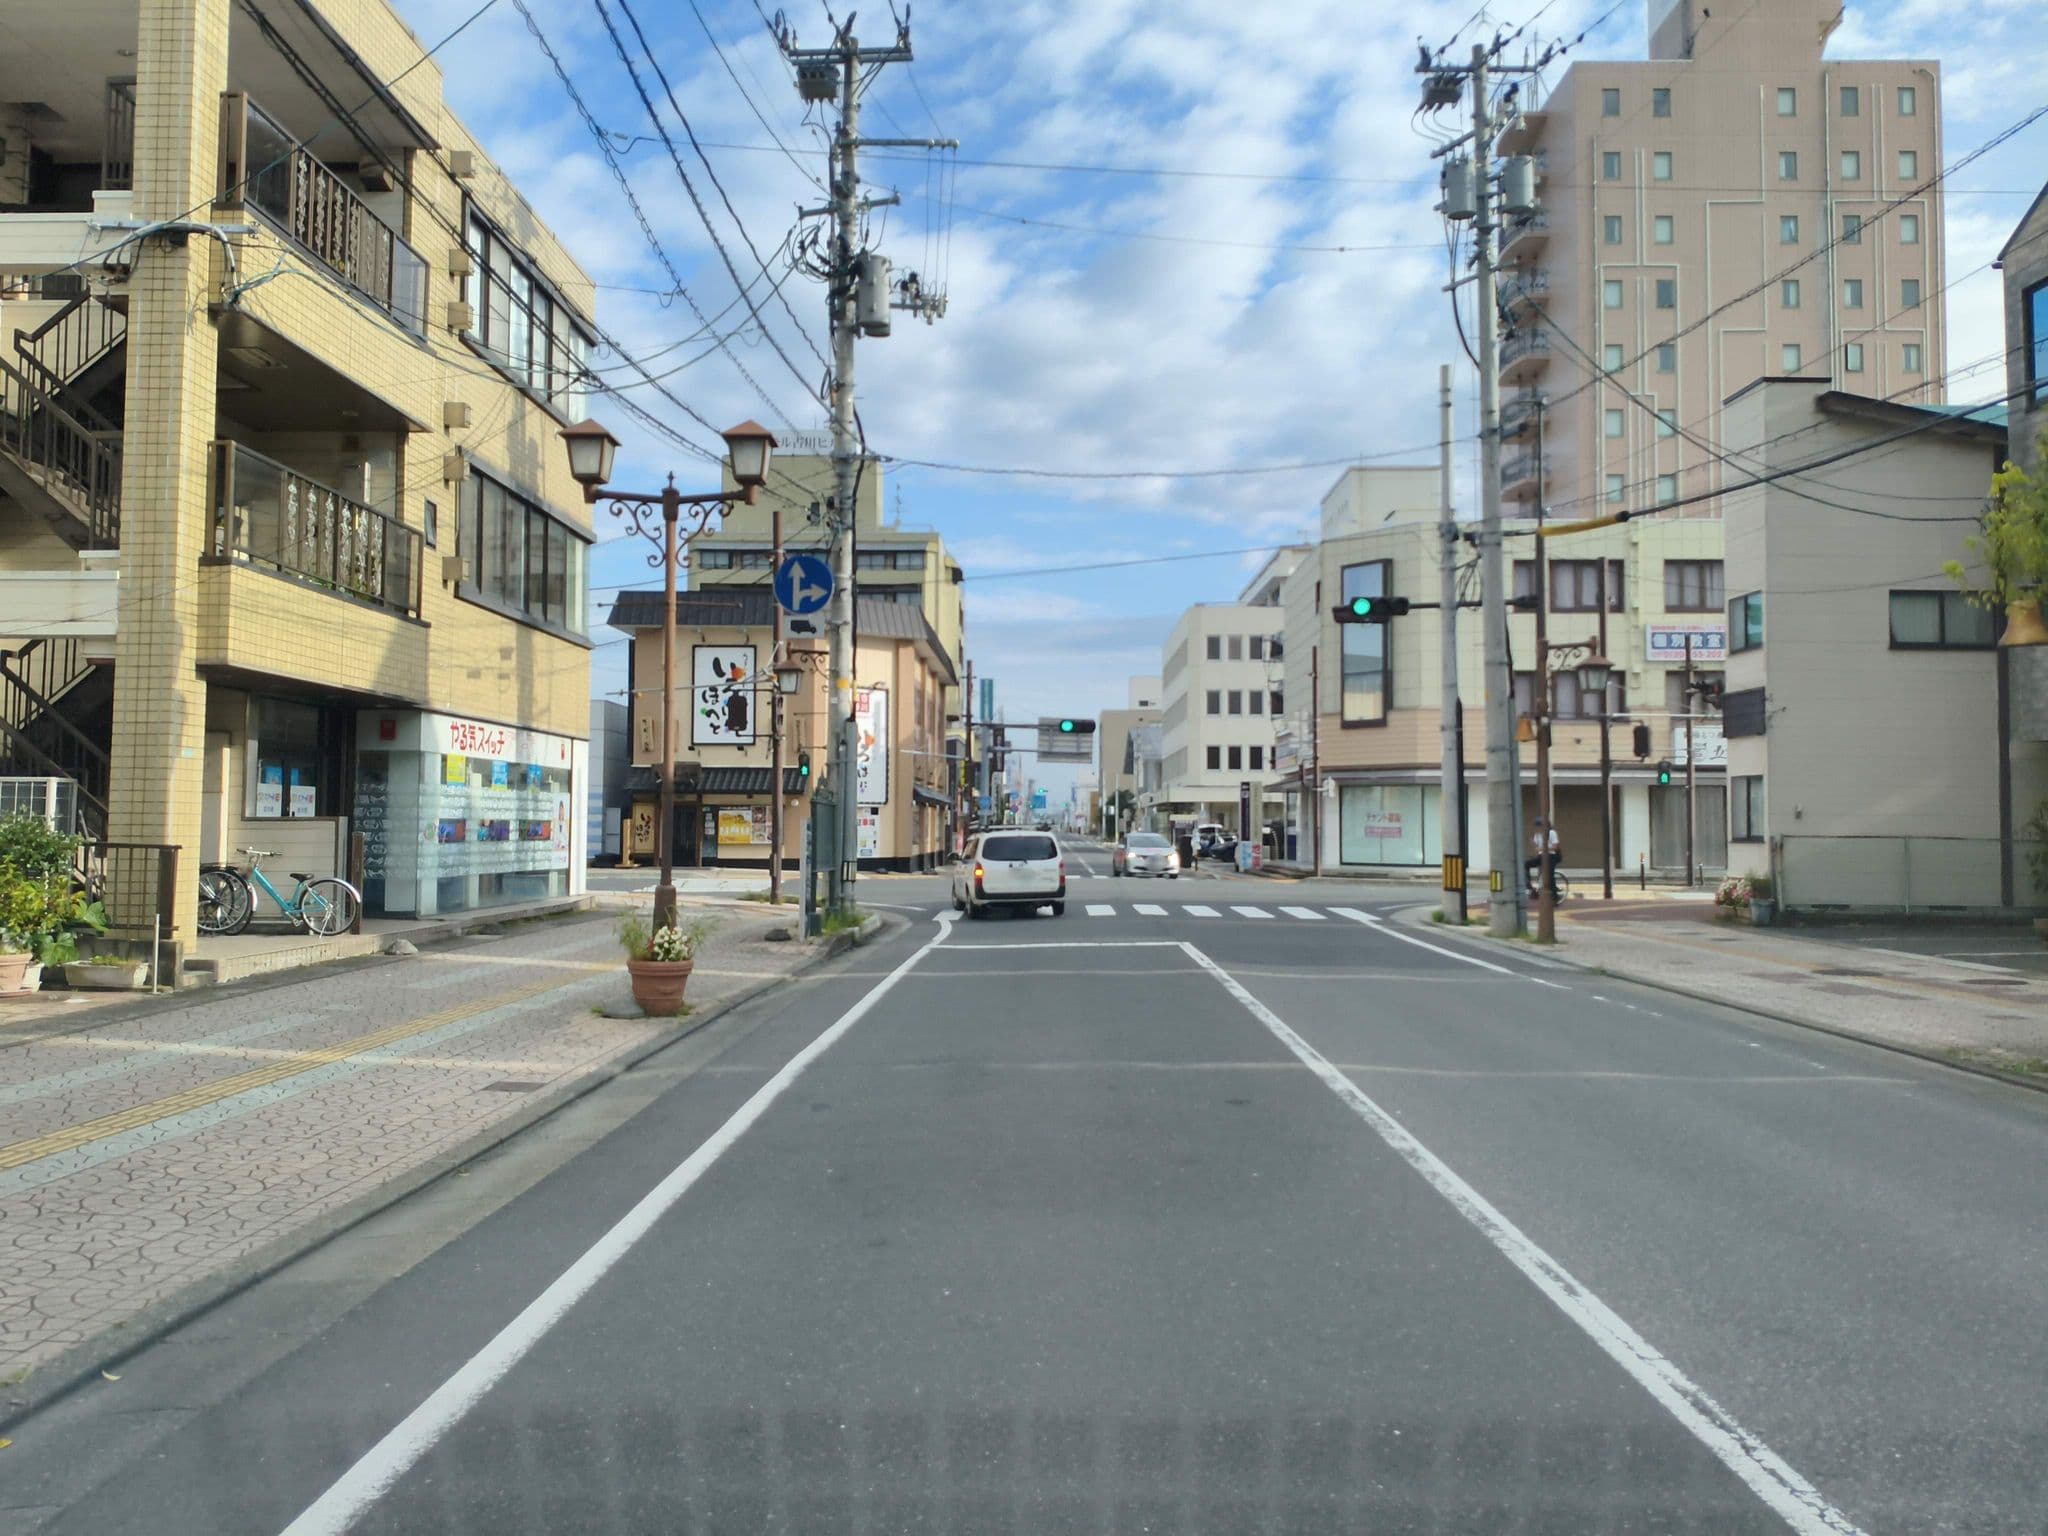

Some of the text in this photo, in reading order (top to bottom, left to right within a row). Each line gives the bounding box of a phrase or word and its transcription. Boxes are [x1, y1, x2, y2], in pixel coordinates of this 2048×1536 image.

[450, 720, 505, 755] やる気スイッチ
